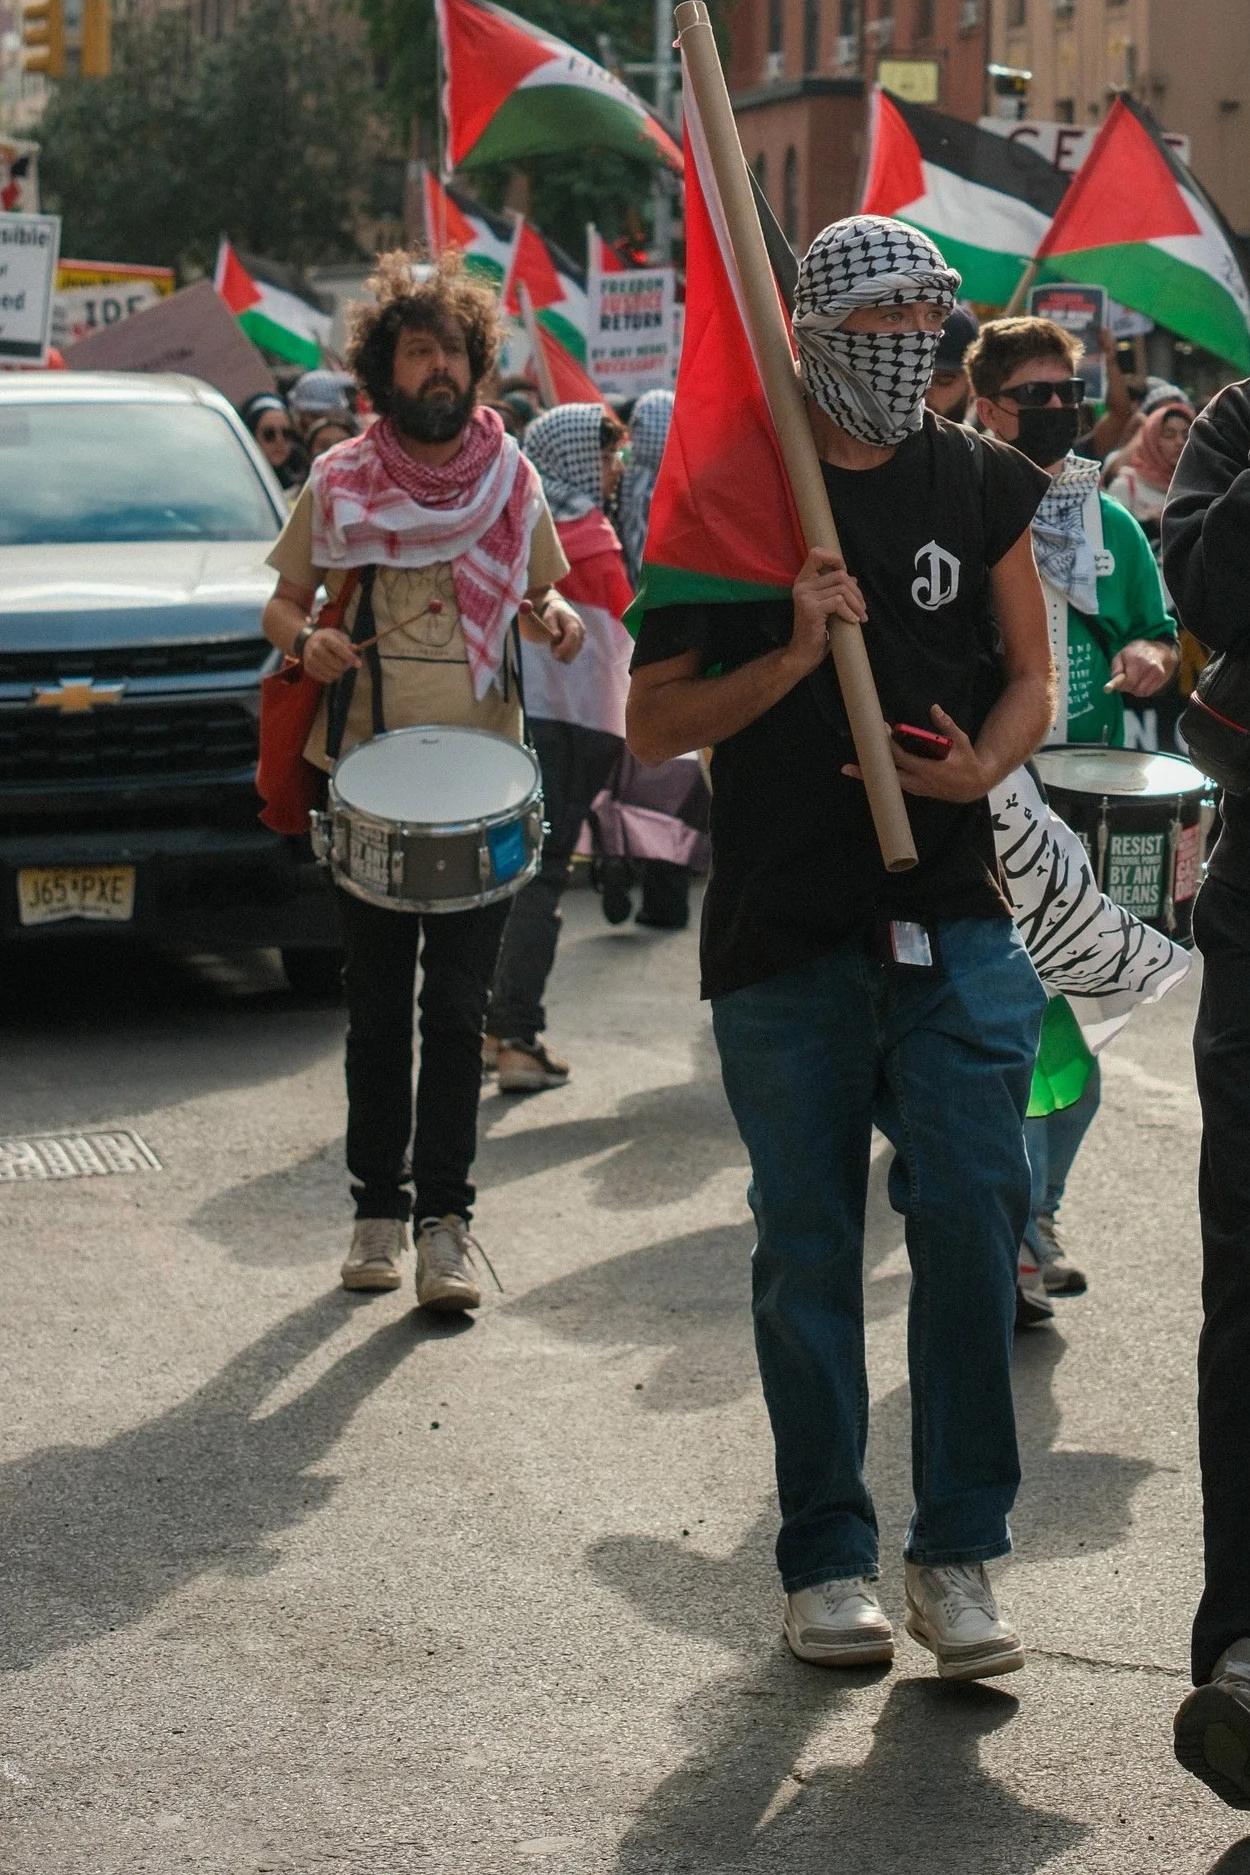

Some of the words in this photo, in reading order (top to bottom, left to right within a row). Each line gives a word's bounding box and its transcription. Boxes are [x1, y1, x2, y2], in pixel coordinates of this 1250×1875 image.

[1111, 835, 1164, 857] RESIST
[1111, 866, 1130, 885] BY
[1133, 865, 1161, 885] ANY
[1110, 885, 1159, 905] MEANS
